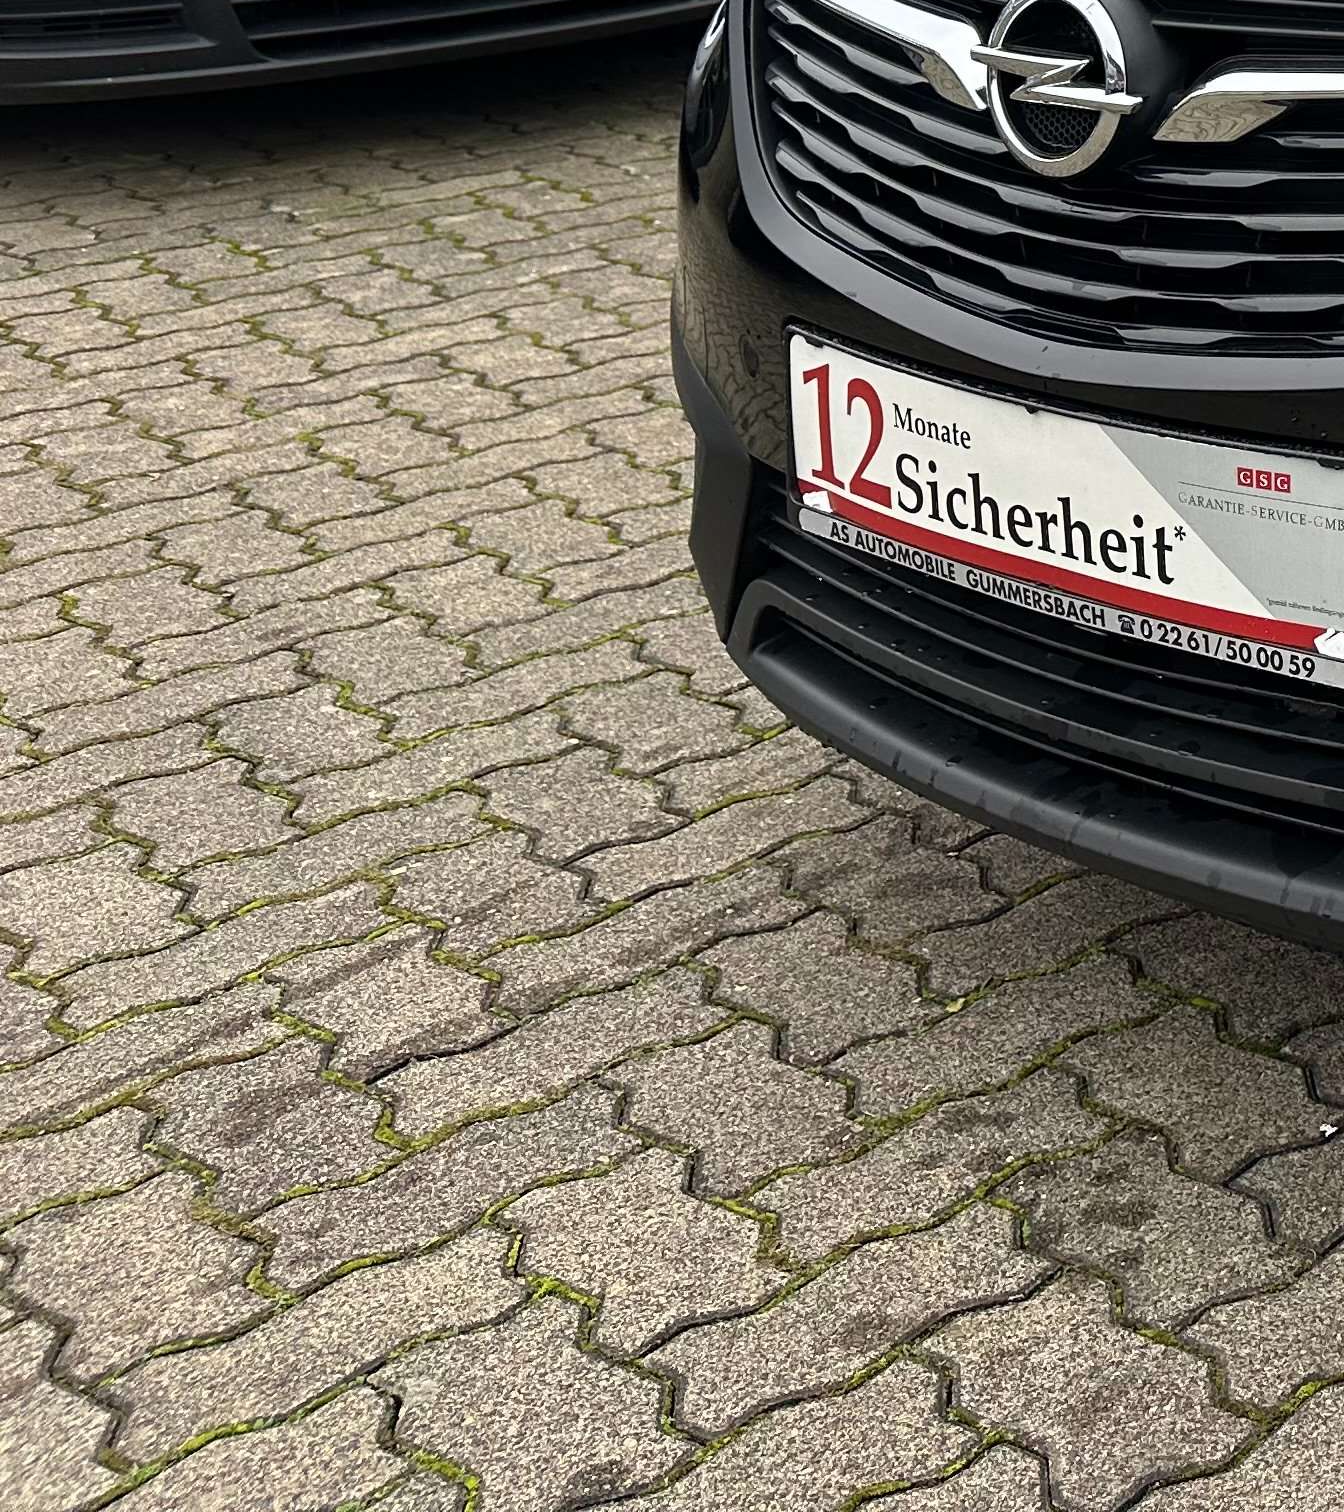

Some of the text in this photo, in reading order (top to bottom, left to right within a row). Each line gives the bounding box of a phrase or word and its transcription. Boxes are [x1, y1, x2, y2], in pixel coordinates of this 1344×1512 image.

[802, 363, 893, 510] 12
[892, 402, 972, 450] Monate
[1238, 469, 1290, 492] GSG
[829, 521, 850, 545] AS
[854, 532, 957, 582] AUTOMOBILE
[966, 568, 1107, 629] GUMMERSBACH
